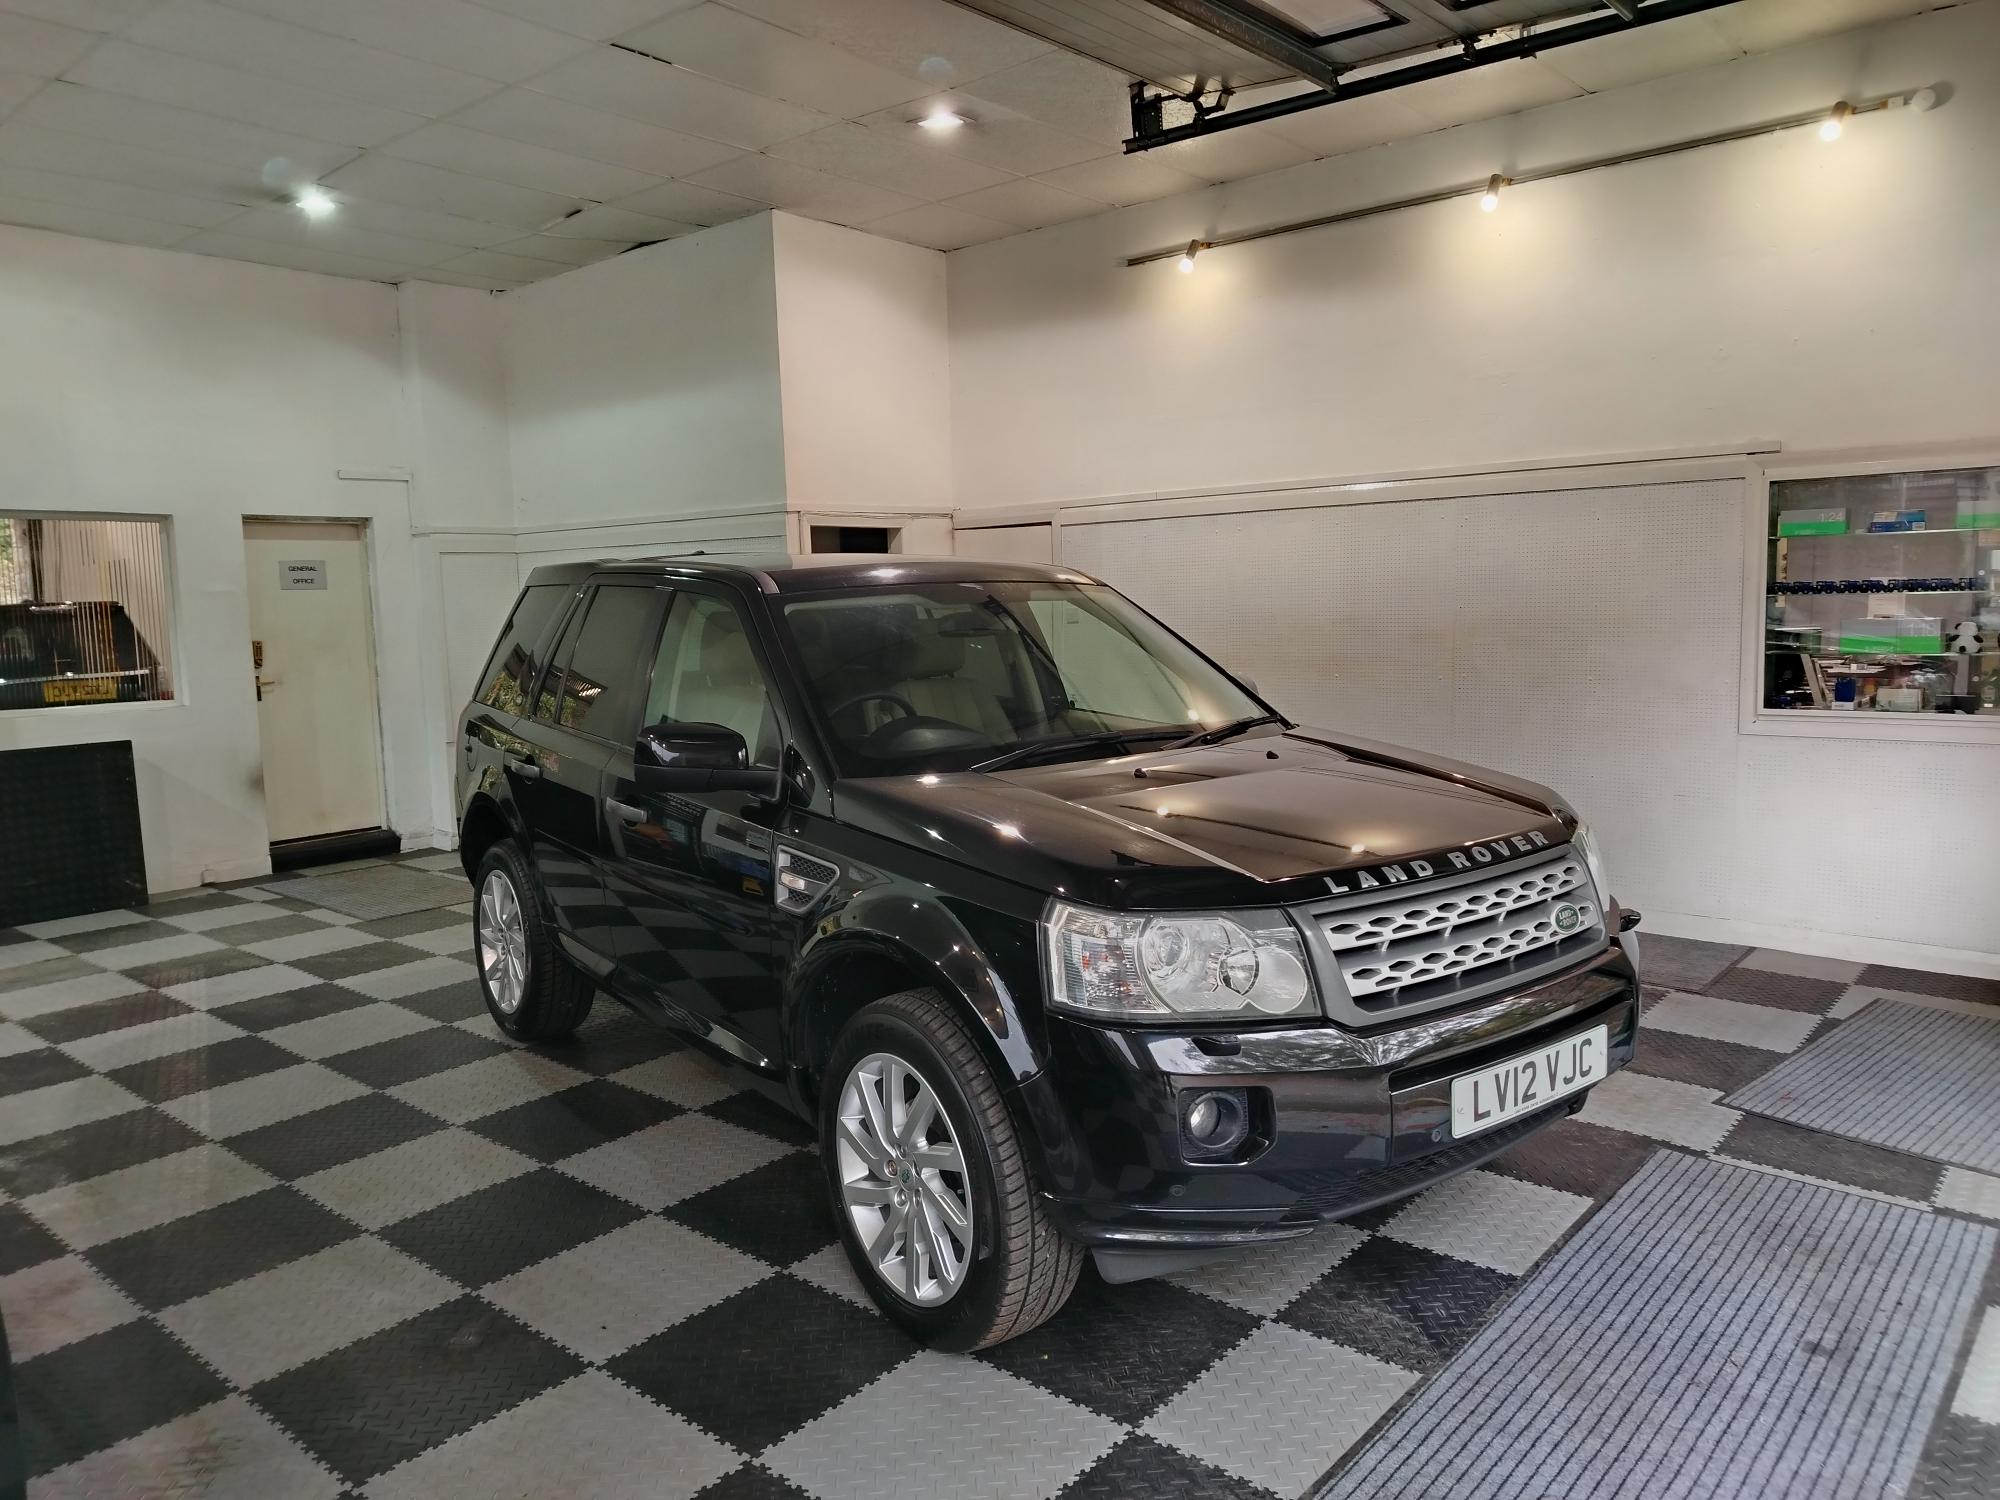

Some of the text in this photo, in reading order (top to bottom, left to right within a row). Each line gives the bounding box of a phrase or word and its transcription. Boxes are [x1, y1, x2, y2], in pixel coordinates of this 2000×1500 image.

[1322, 830, 1549, 894] LAND ROVER
[1473, 1037, 1593, 1123] LV12 VJC
